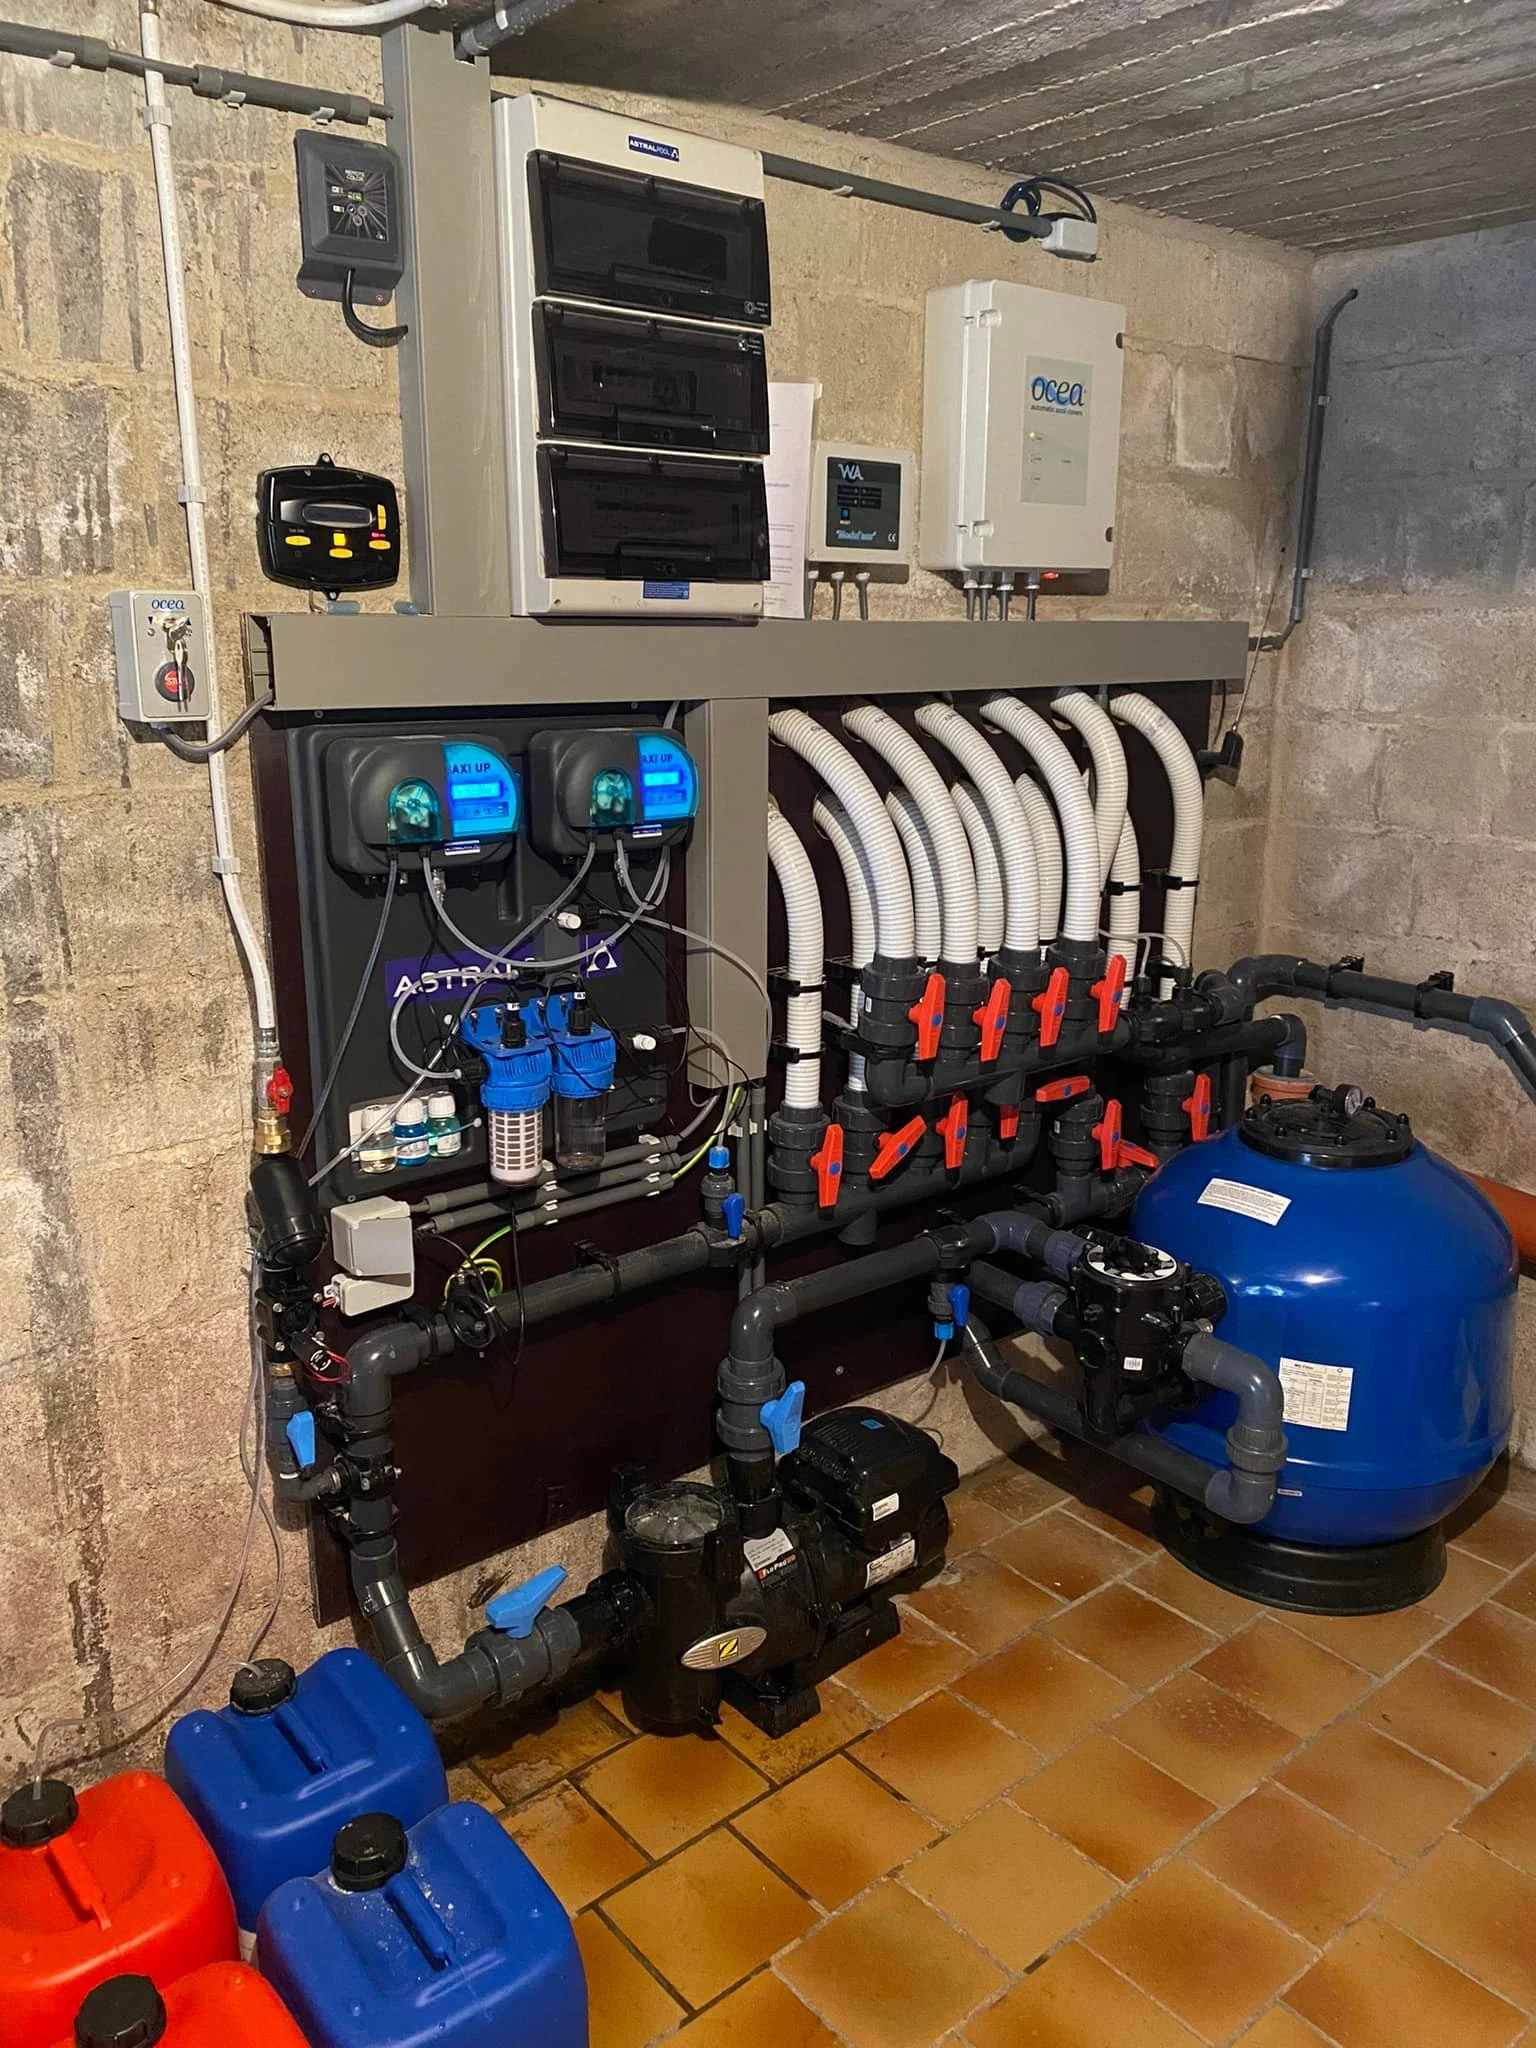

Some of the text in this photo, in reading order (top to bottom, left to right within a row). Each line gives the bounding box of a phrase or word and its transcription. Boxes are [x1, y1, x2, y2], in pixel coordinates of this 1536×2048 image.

[1031, 376, 1084, 406] ocea
[151, 599, 185, 610] ocea
[660, 753, 672, 762] UP
[450, 763, 491, 774] AXI UP
